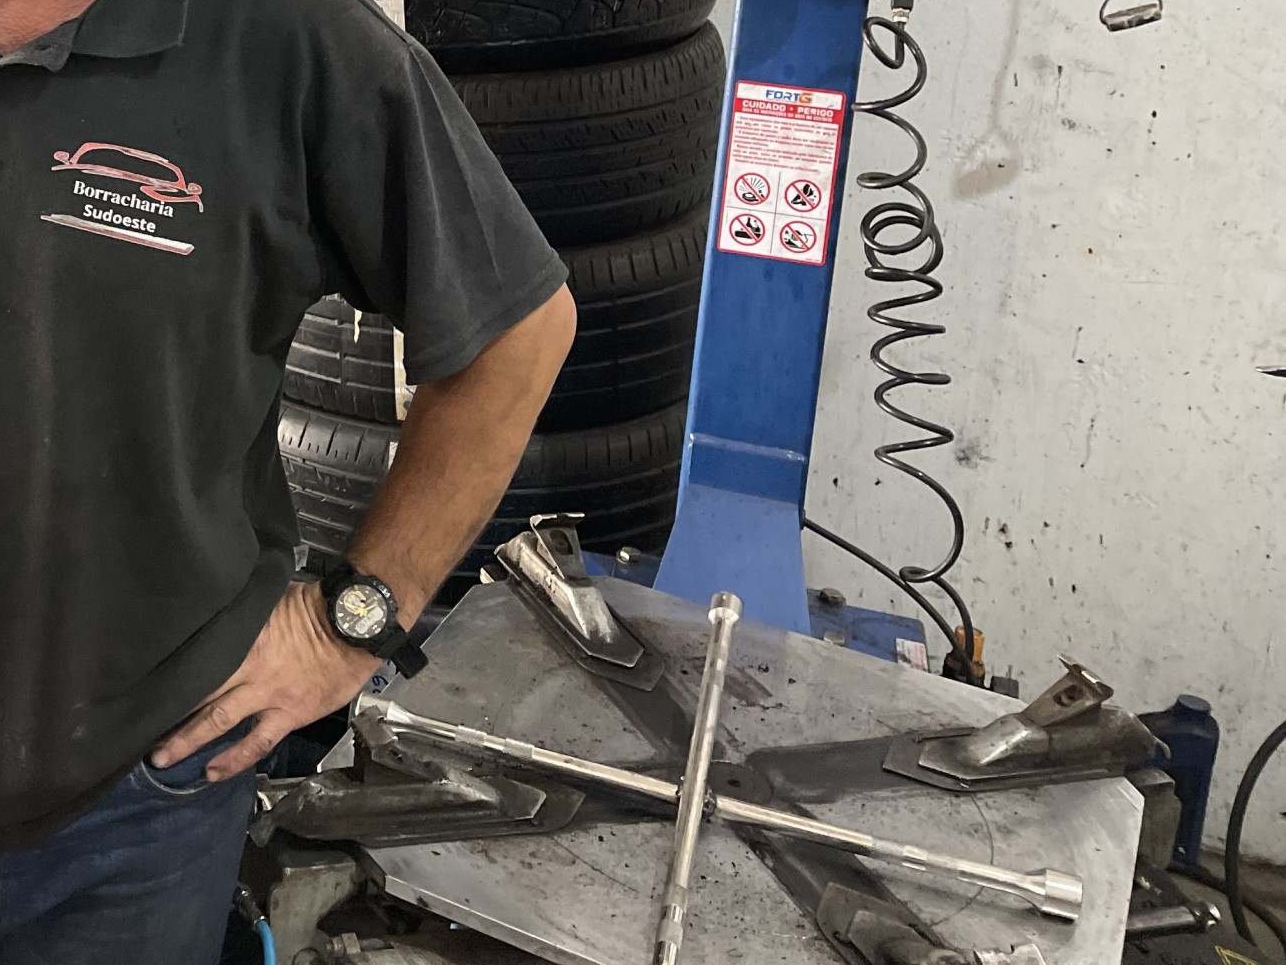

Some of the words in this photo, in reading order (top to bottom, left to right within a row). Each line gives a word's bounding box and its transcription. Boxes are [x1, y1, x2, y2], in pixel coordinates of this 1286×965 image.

[742, 100, 786, 112] CUIDADO
[797, 106, 834, 117] PERIGO
[73, 180, 174, 218] Borracharia
[83, 204, 156, 233] Sudoeste
